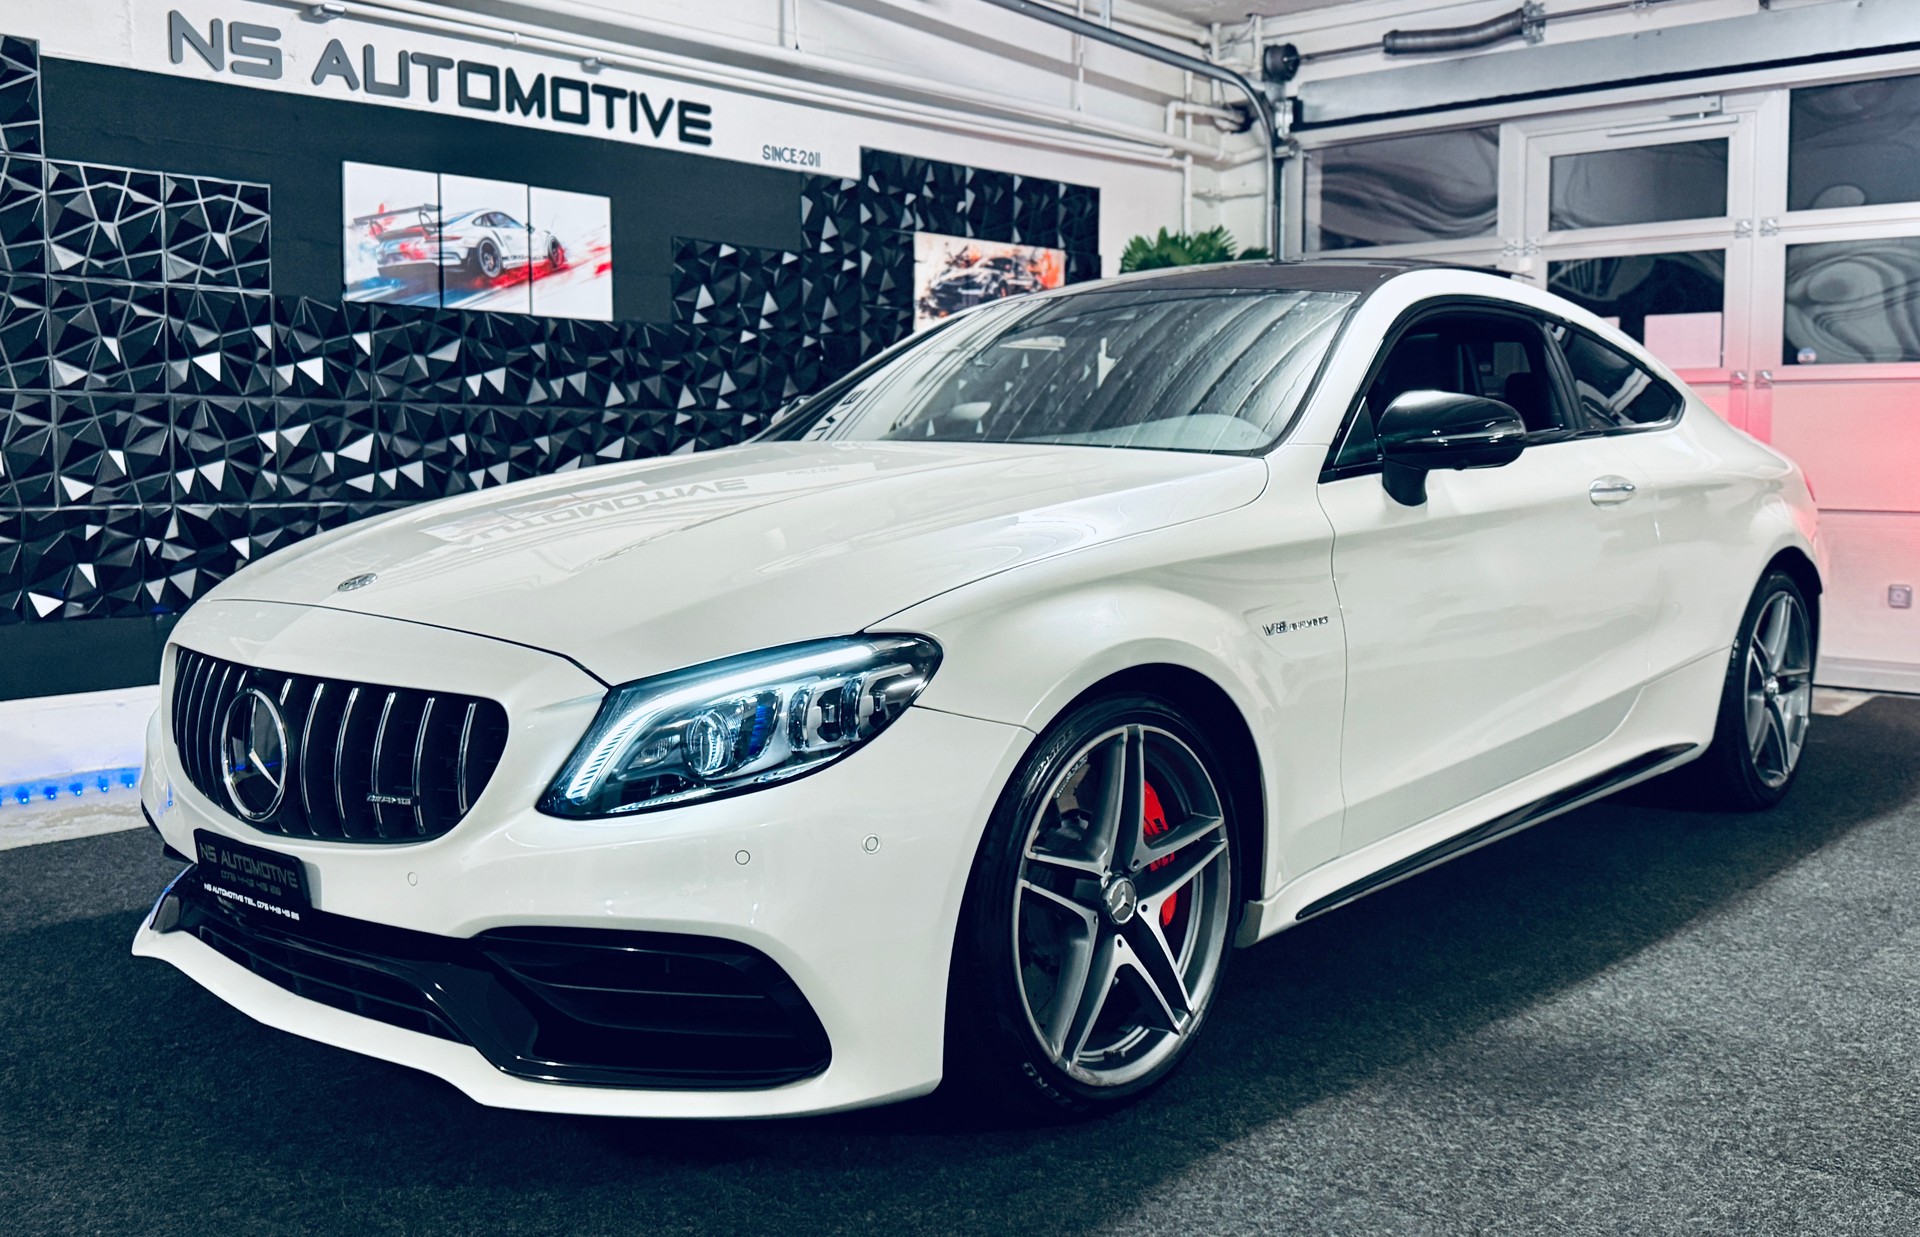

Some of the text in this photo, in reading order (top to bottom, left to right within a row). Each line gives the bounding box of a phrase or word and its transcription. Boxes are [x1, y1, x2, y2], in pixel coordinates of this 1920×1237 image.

[169, 9, 713, 147] NS AUTOMOTIVE
[762, 144, 821, 168] SINCE 2011
[1262, 621, 1287, 636] V8
[199, 842, 298, 888] NS AUTOMOTIVE
